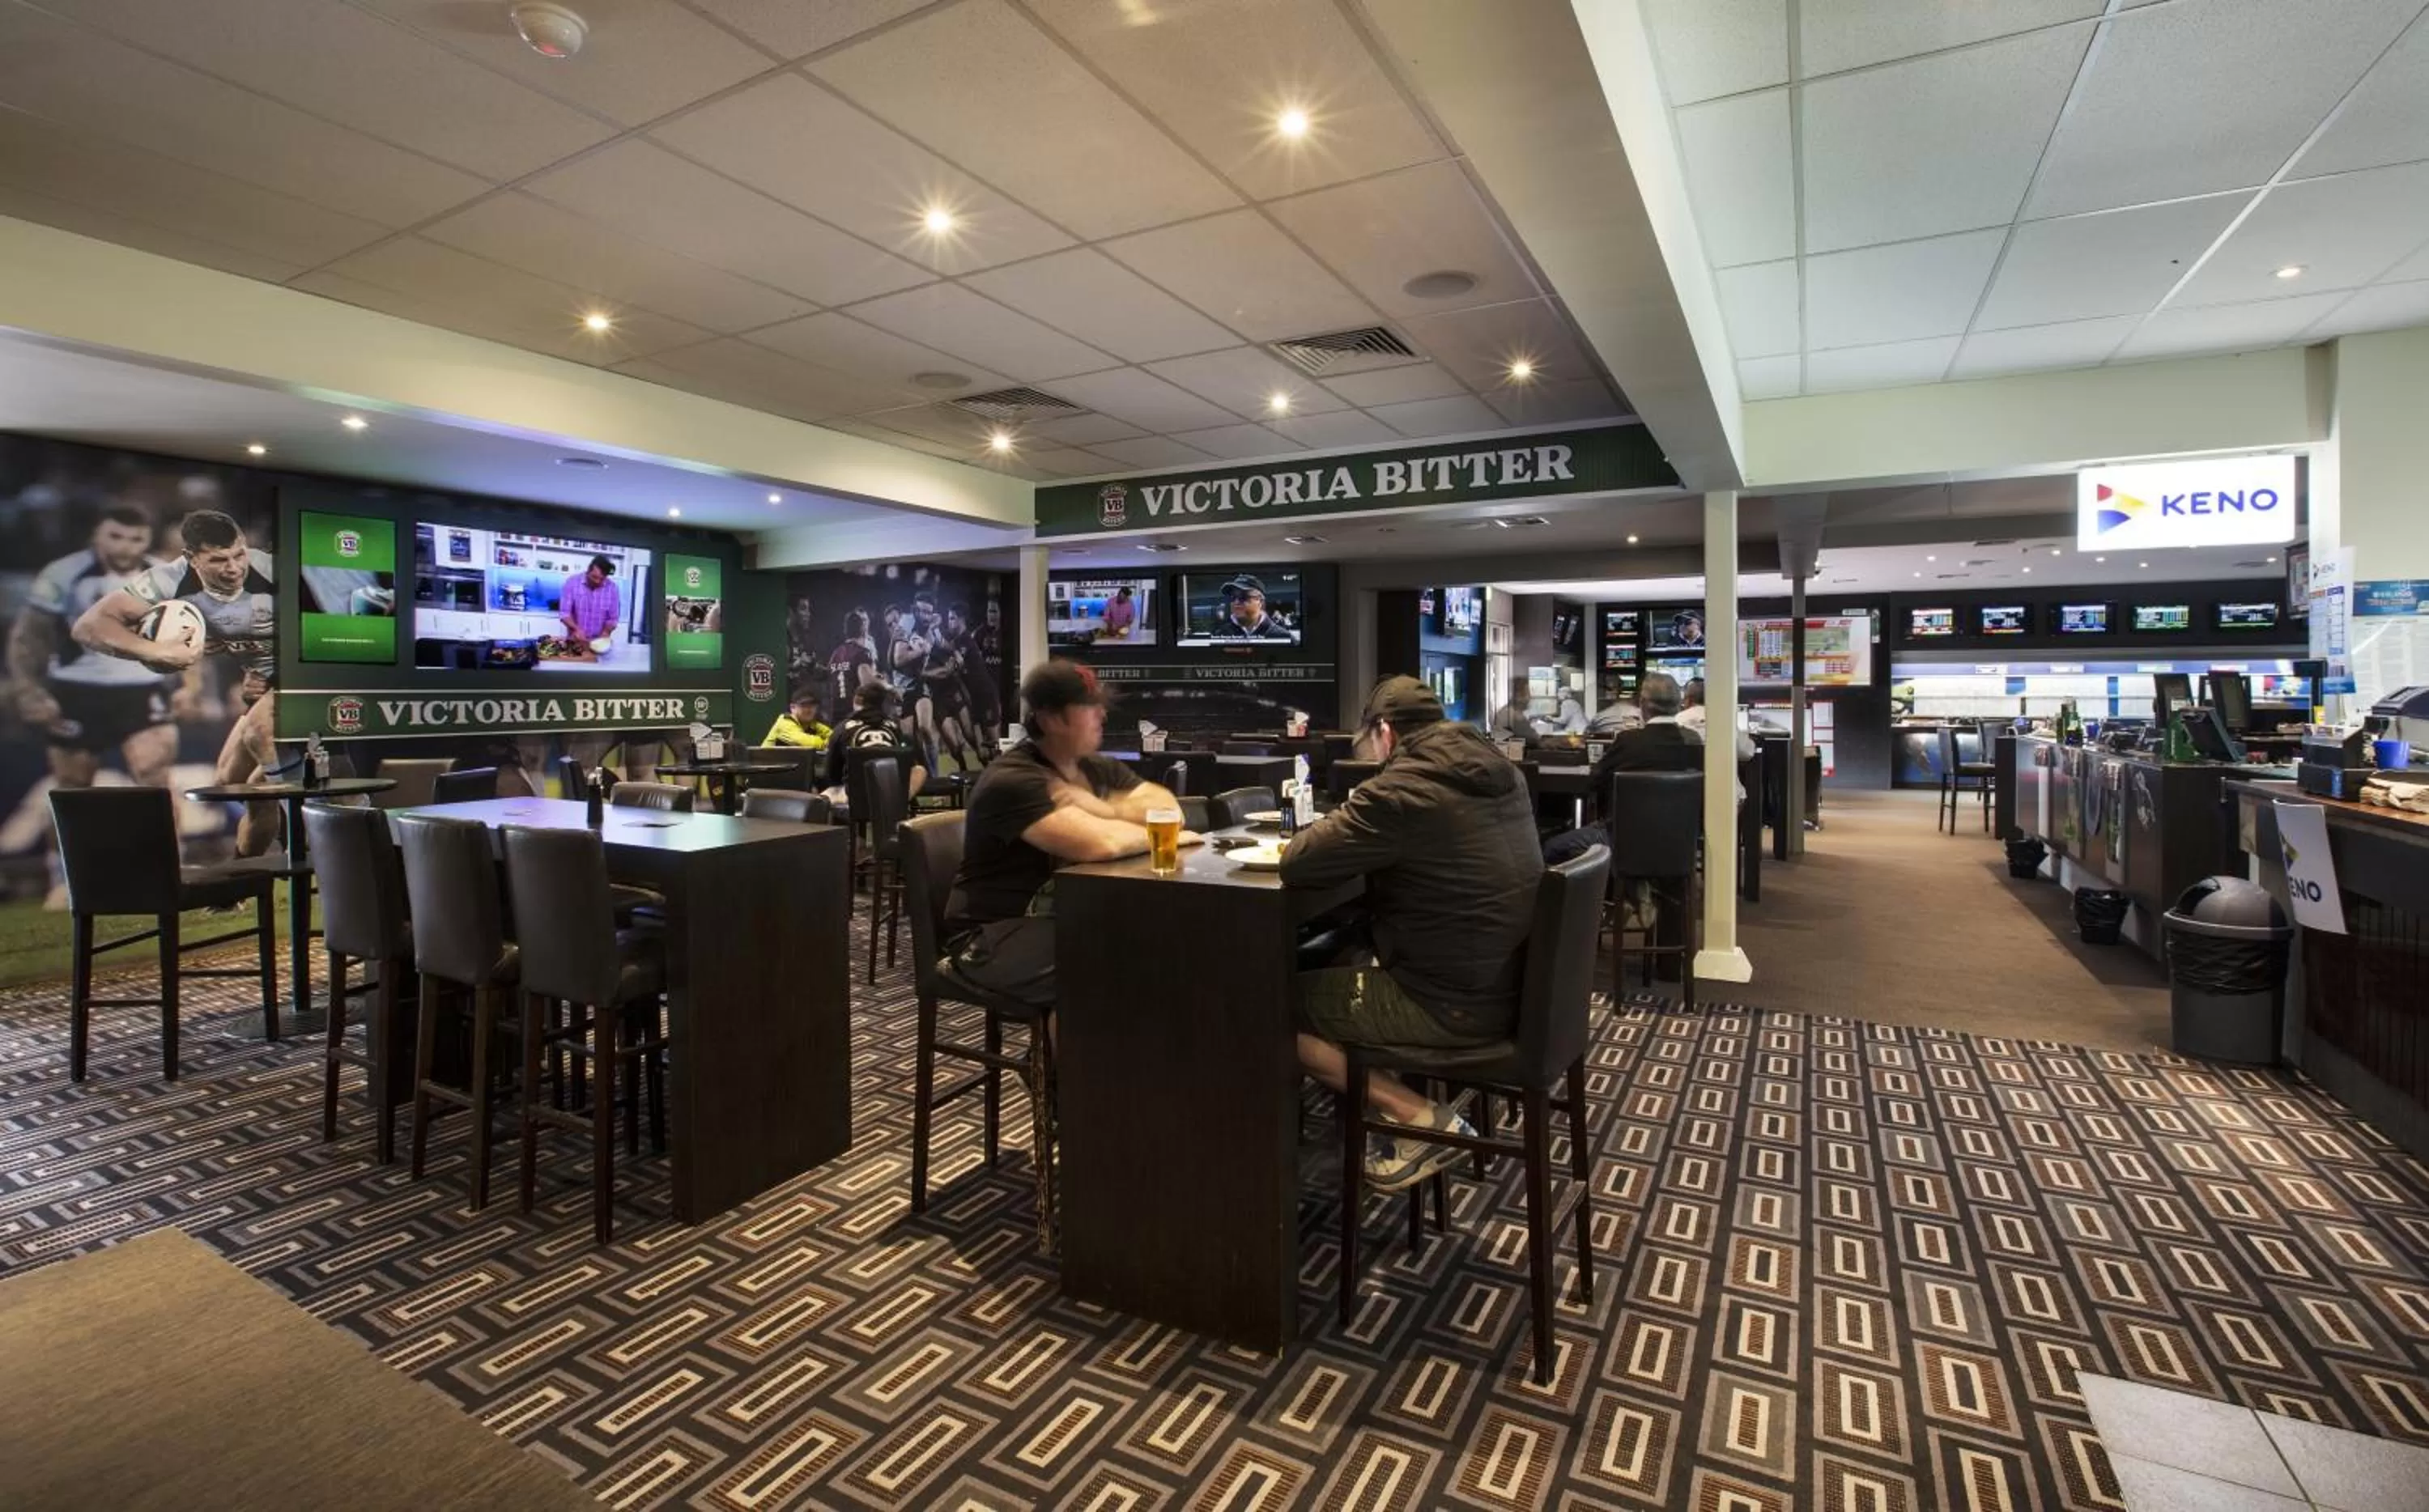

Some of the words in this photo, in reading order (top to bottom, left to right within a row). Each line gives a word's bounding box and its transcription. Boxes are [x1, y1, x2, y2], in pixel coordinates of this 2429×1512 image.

[1141, 466, 1361, 516] VICTORIA
[1372, 444, 1576, 497] BITTER
[1106, 499, 1123, 510] VB
[2162, 488, 2278, 516] KENO
[753, 672, 769, 683] VB
[1195, 668, 1255, 678] VICTORIA
[1259, 668, 1305, 677] BITTER
[339, 709, 359, 720] VB
[376, 699, 567, 726] VICTORIA
[573, 699, 685, 721] BITTER
[2289, 875, 2322, 903] ENO
